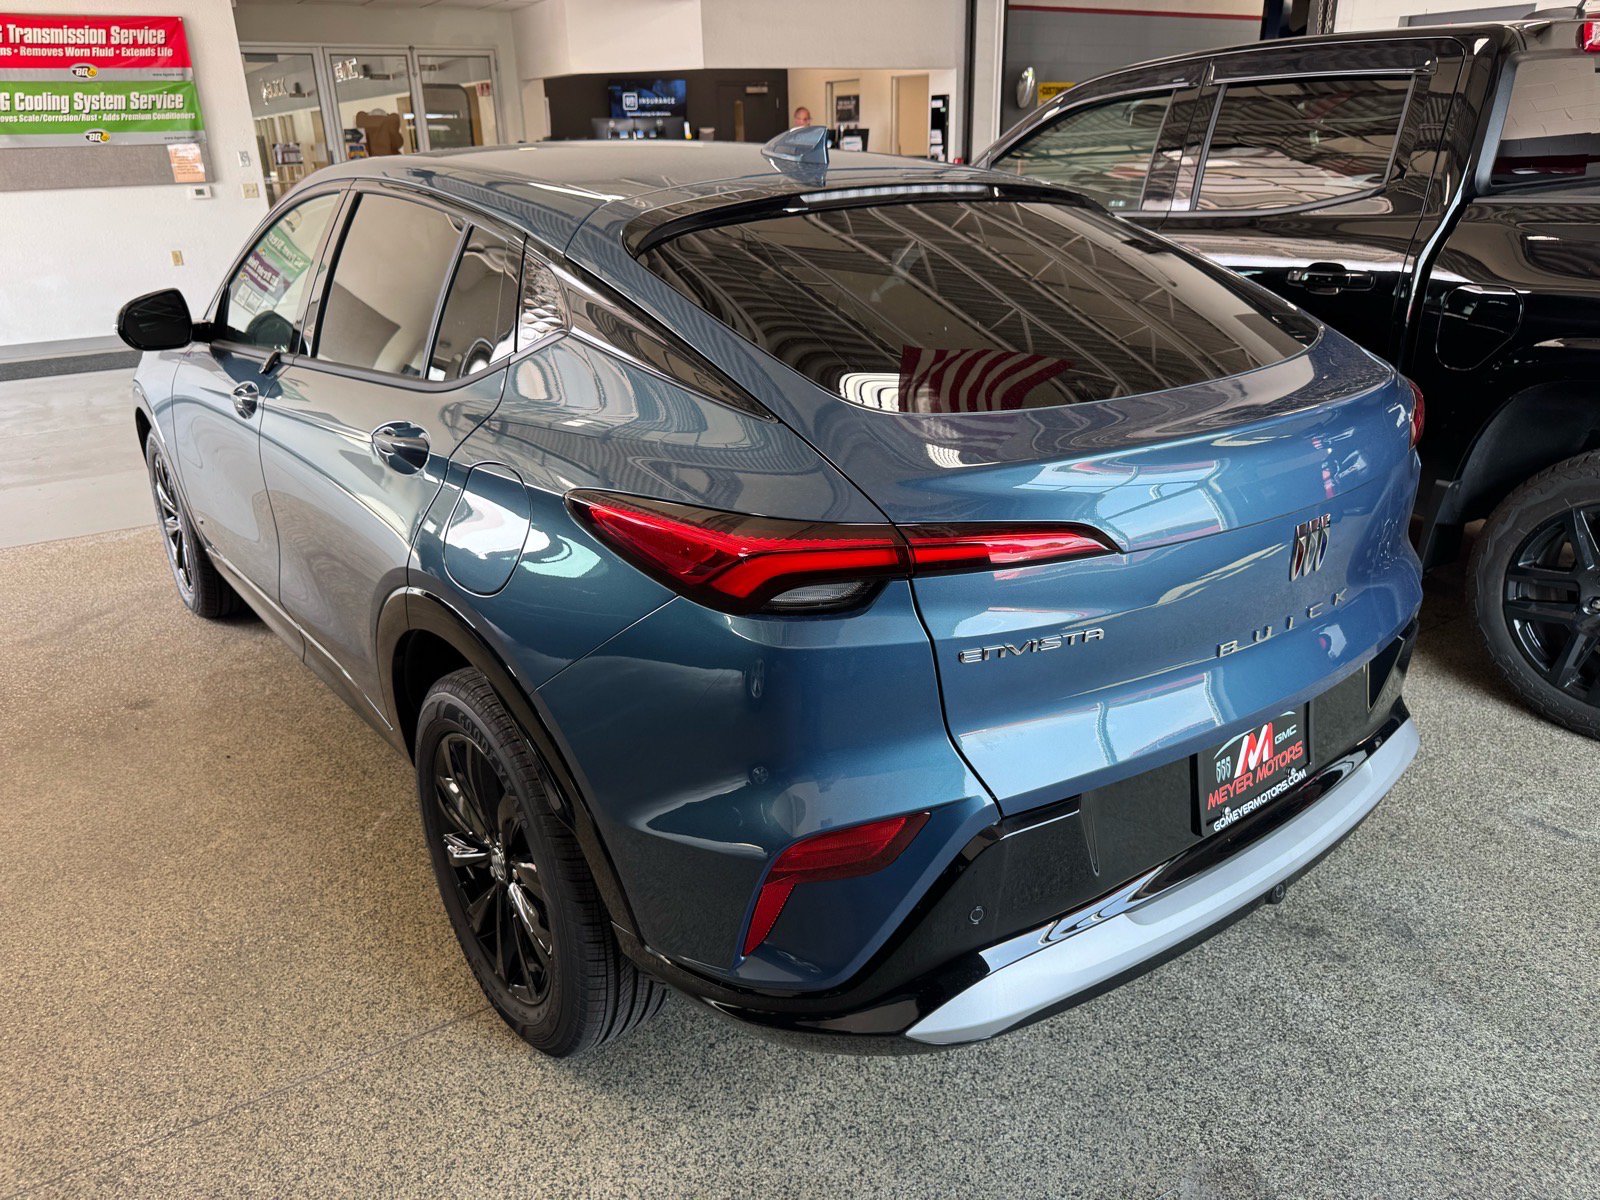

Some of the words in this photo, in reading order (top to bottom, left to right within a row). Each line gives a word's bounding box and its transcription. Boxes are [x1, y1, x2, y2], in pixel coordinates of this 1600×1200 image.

[7, 24, 107, 44] Transmission
[110, 26, 166, 45] Service
[20, 46, 64, 56] Removes
[65, 47, 91, 57] Worn
[92, 47, 114, 57] Fluid
[121, 47, 156, 57] Extends
[157, 47, 173, 57] Life
[14, 92, 70, 114] Cooling
[73, 92, 126, 114] System
[130, 91, 184, 110] Service
[102, 113, 121, 121] Adds
[121, 112, 152, 121] Premium
[152, 112, 196, 120] Conditioners
[1217, 588, 1347, 658] BUICK
[959, 628, 1105, 664] ENVISTA
[1274, 724, 1297, 745] GMC
[1207, 772, 1254, 811] MEYER
[1256, 740, 1303, 783] MOTORS
[1213, 768, 1307, 832] GOMEYERMOTORS.COM
